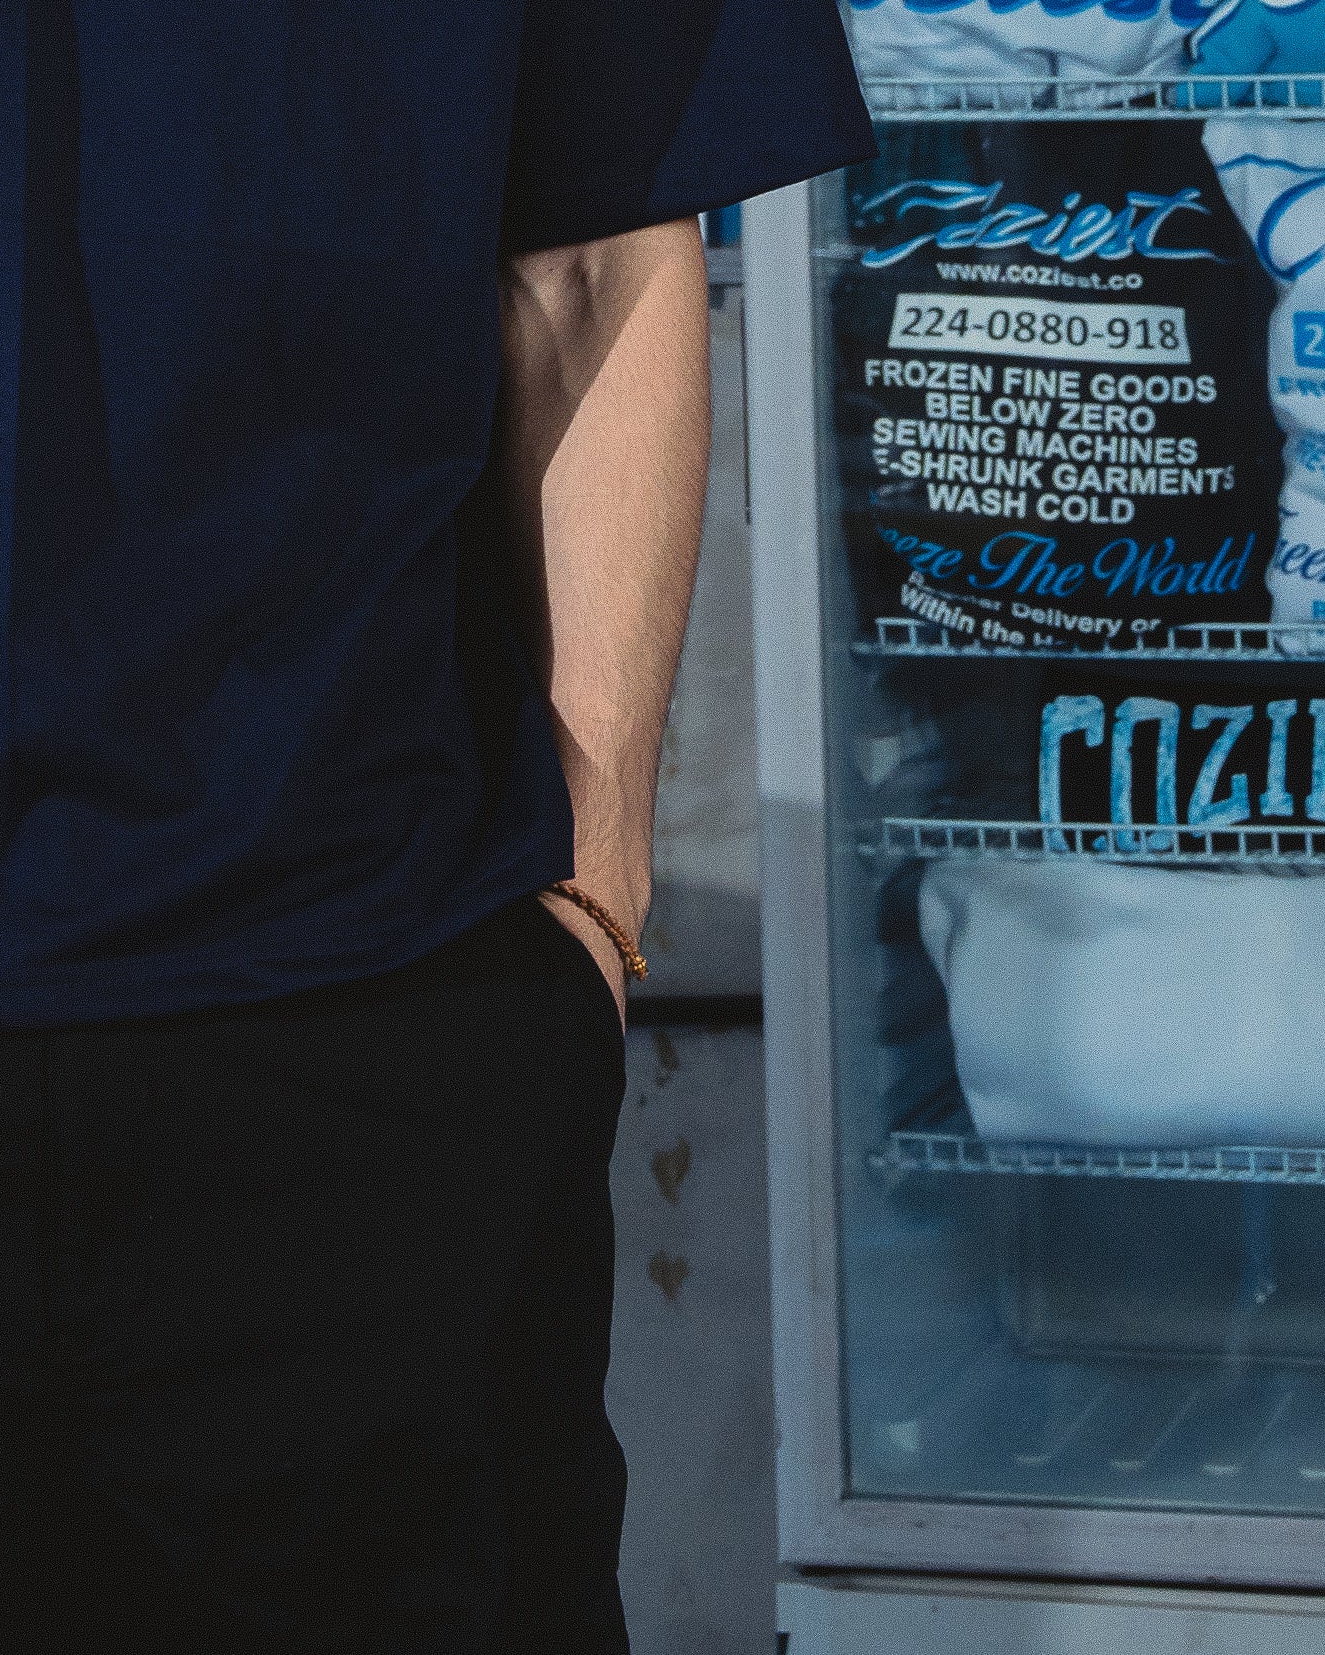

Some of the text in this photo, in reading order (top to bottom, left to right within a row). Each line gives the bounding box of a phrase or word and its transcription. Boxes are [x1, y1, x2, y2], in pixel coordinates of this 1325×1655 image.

[901, 307, 1179, 351] 224-0880-918
[865, 360, 1218, 404] FROZEN FINE GOODS
[926, 392, 1156, 434] BELOW ZERO
[873, 418, 1199, 465] SEWING MACHINES
[927, 483, 1135, 525] WASH COLD
[968, 531, 1085, 597] The
[1092, 531, 1256, 597] World
[900, 583, 976, 634] Within
[981, 618, 1026, 647] the
[1011, 601, 1162, 638] Delivery or
